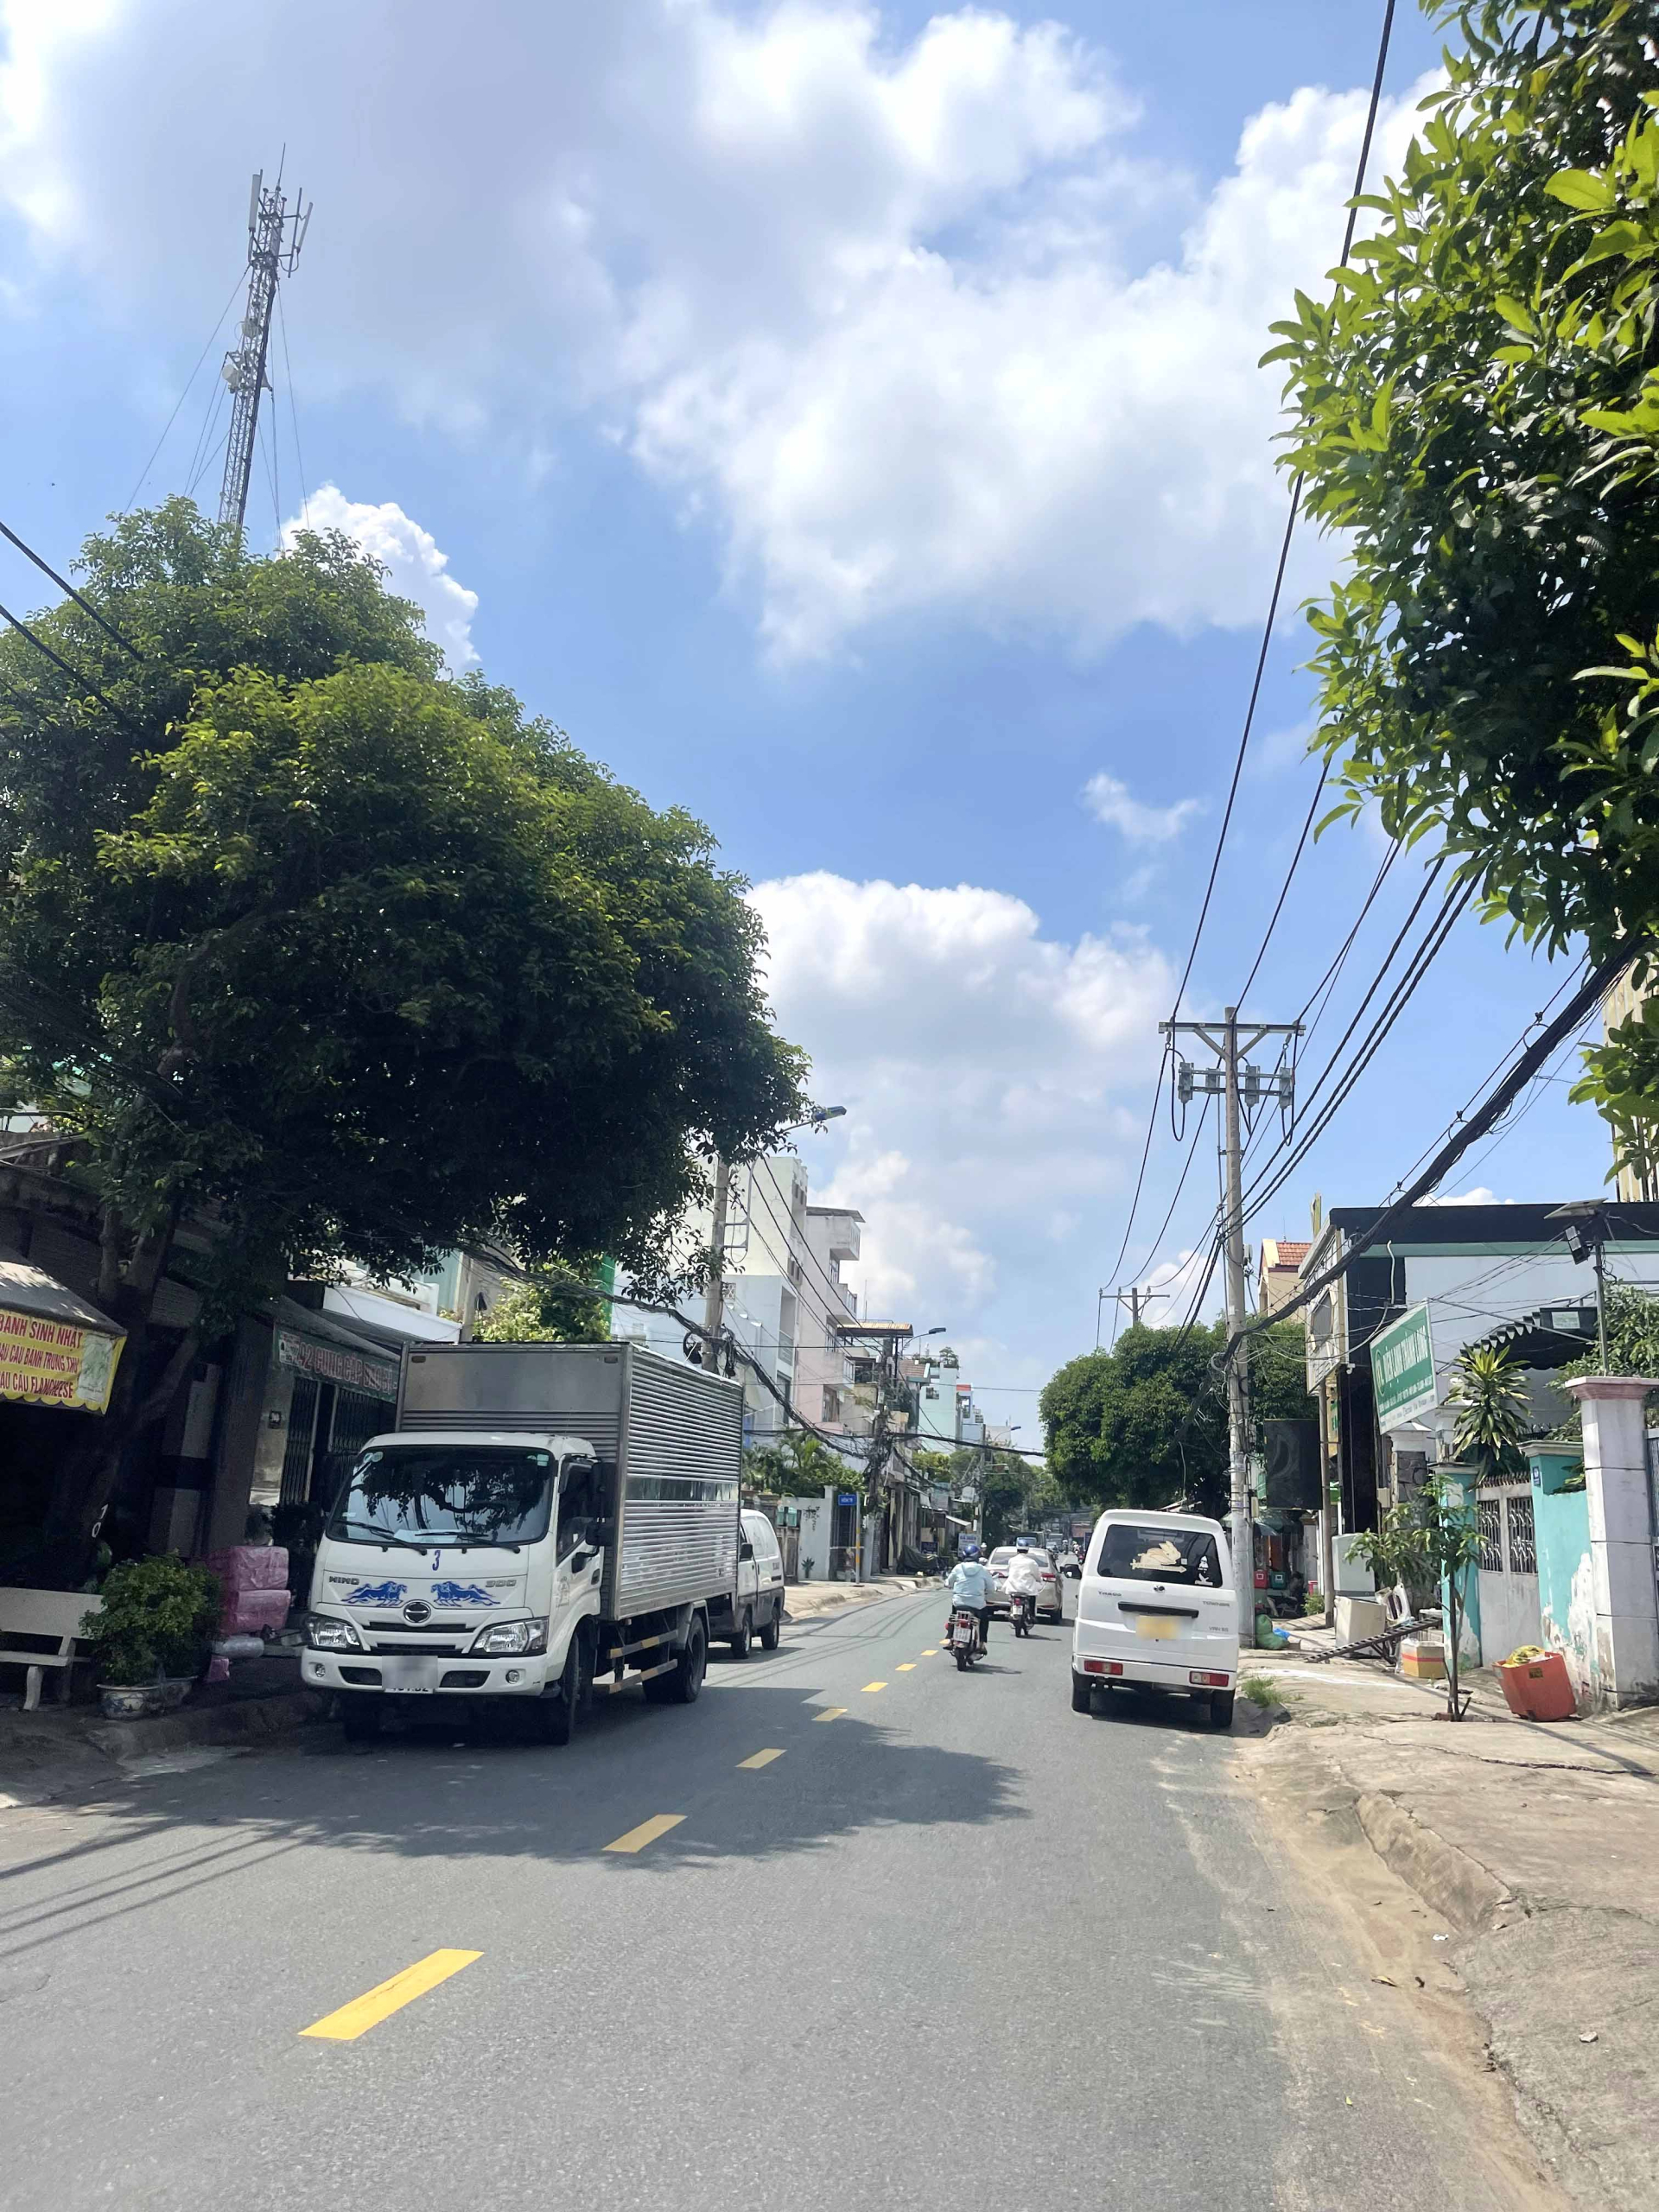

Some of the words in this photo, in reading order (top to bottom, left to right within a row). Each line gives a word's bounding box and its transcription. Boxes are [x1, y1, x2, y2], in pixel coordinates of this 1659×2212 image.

[29, 1321, 55, 1343] SINH
[56, 1326, 83, 1351] NHẬT
[10, 1342, 24, 1364] CÂU
[24, 1345, 43, 1368] BÁNH
[43, 1351, 65, 1371] TRUNG
[66, 1356, 79, 1374] THU
[314, 1346, 343, 1380] CUNG
[13, 1370, 29, 1392] CÂU
[31, 1376, 73, 1398] FLANCHEESE
[432, 1550, 441, 1571] 3
[329, 1576, 359, 1585] HINO
